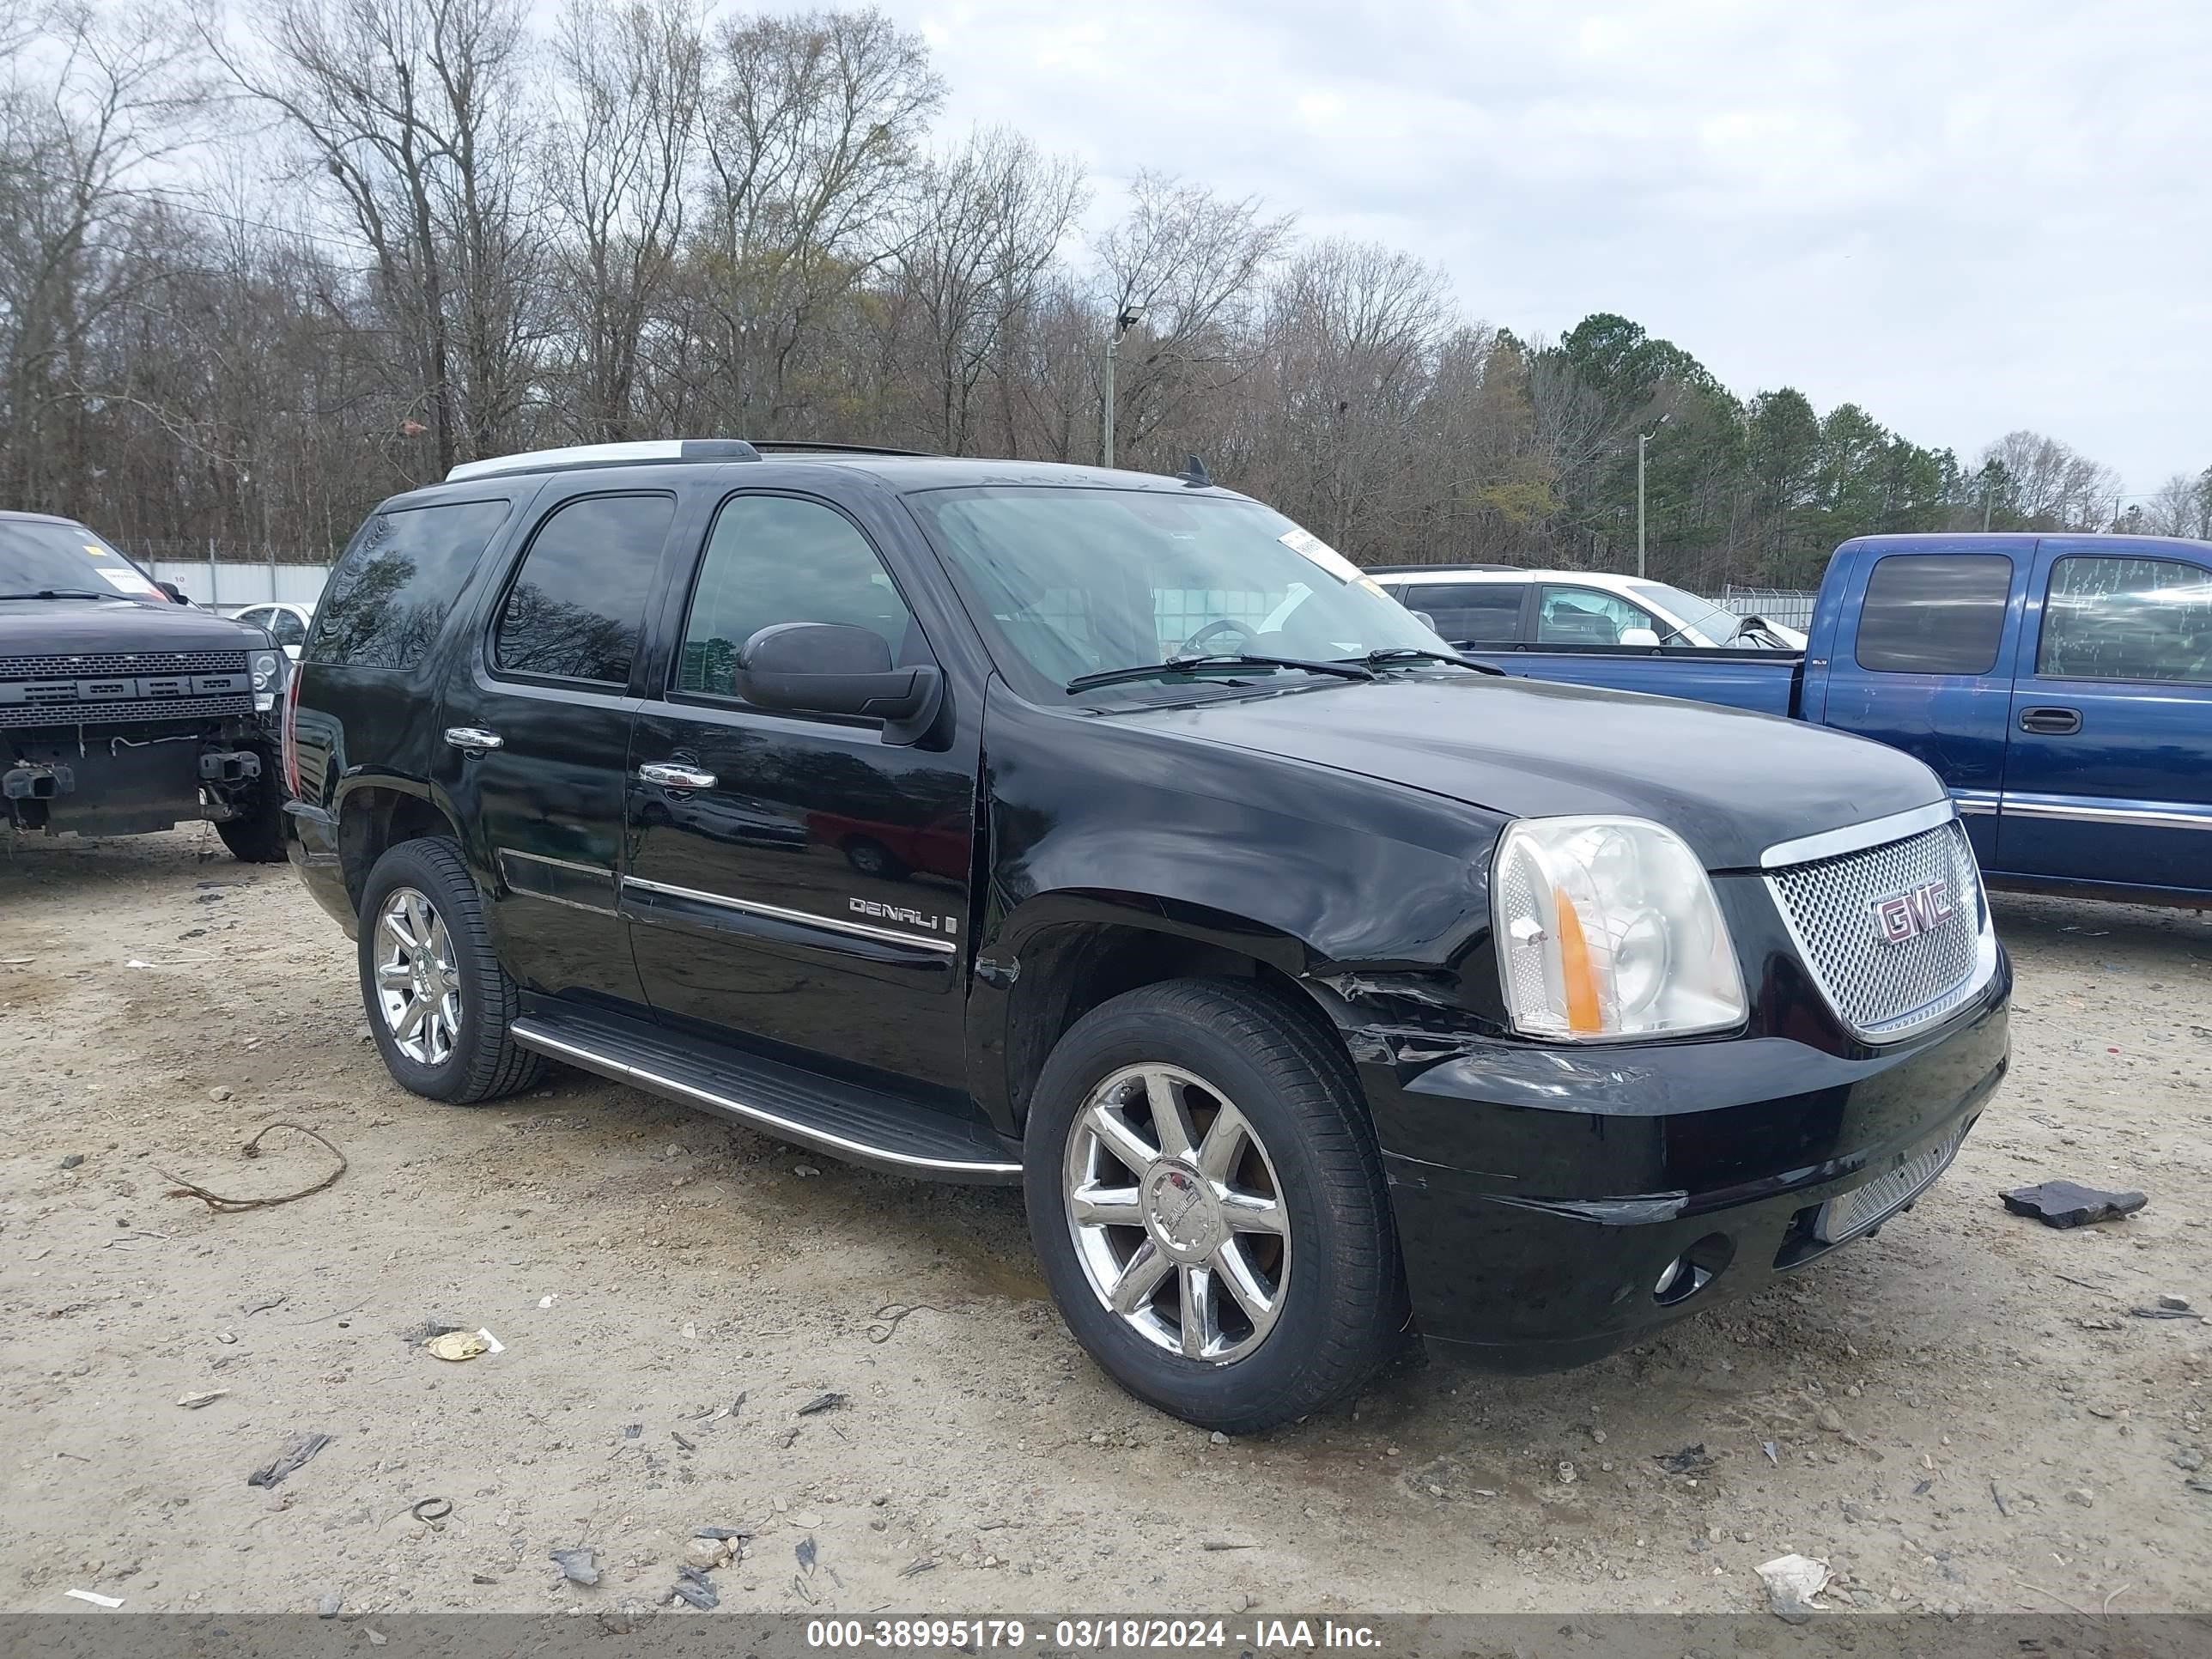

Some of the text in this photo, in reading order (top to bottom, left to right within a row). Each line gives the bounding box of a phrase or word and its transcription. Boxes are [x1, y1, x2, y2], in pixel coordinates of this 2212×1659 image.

[848, 896, 938, 930] DENALI
[1876, 879, 1954, 944] GMC
[1164, 1187, 1201, 1232] GMC
